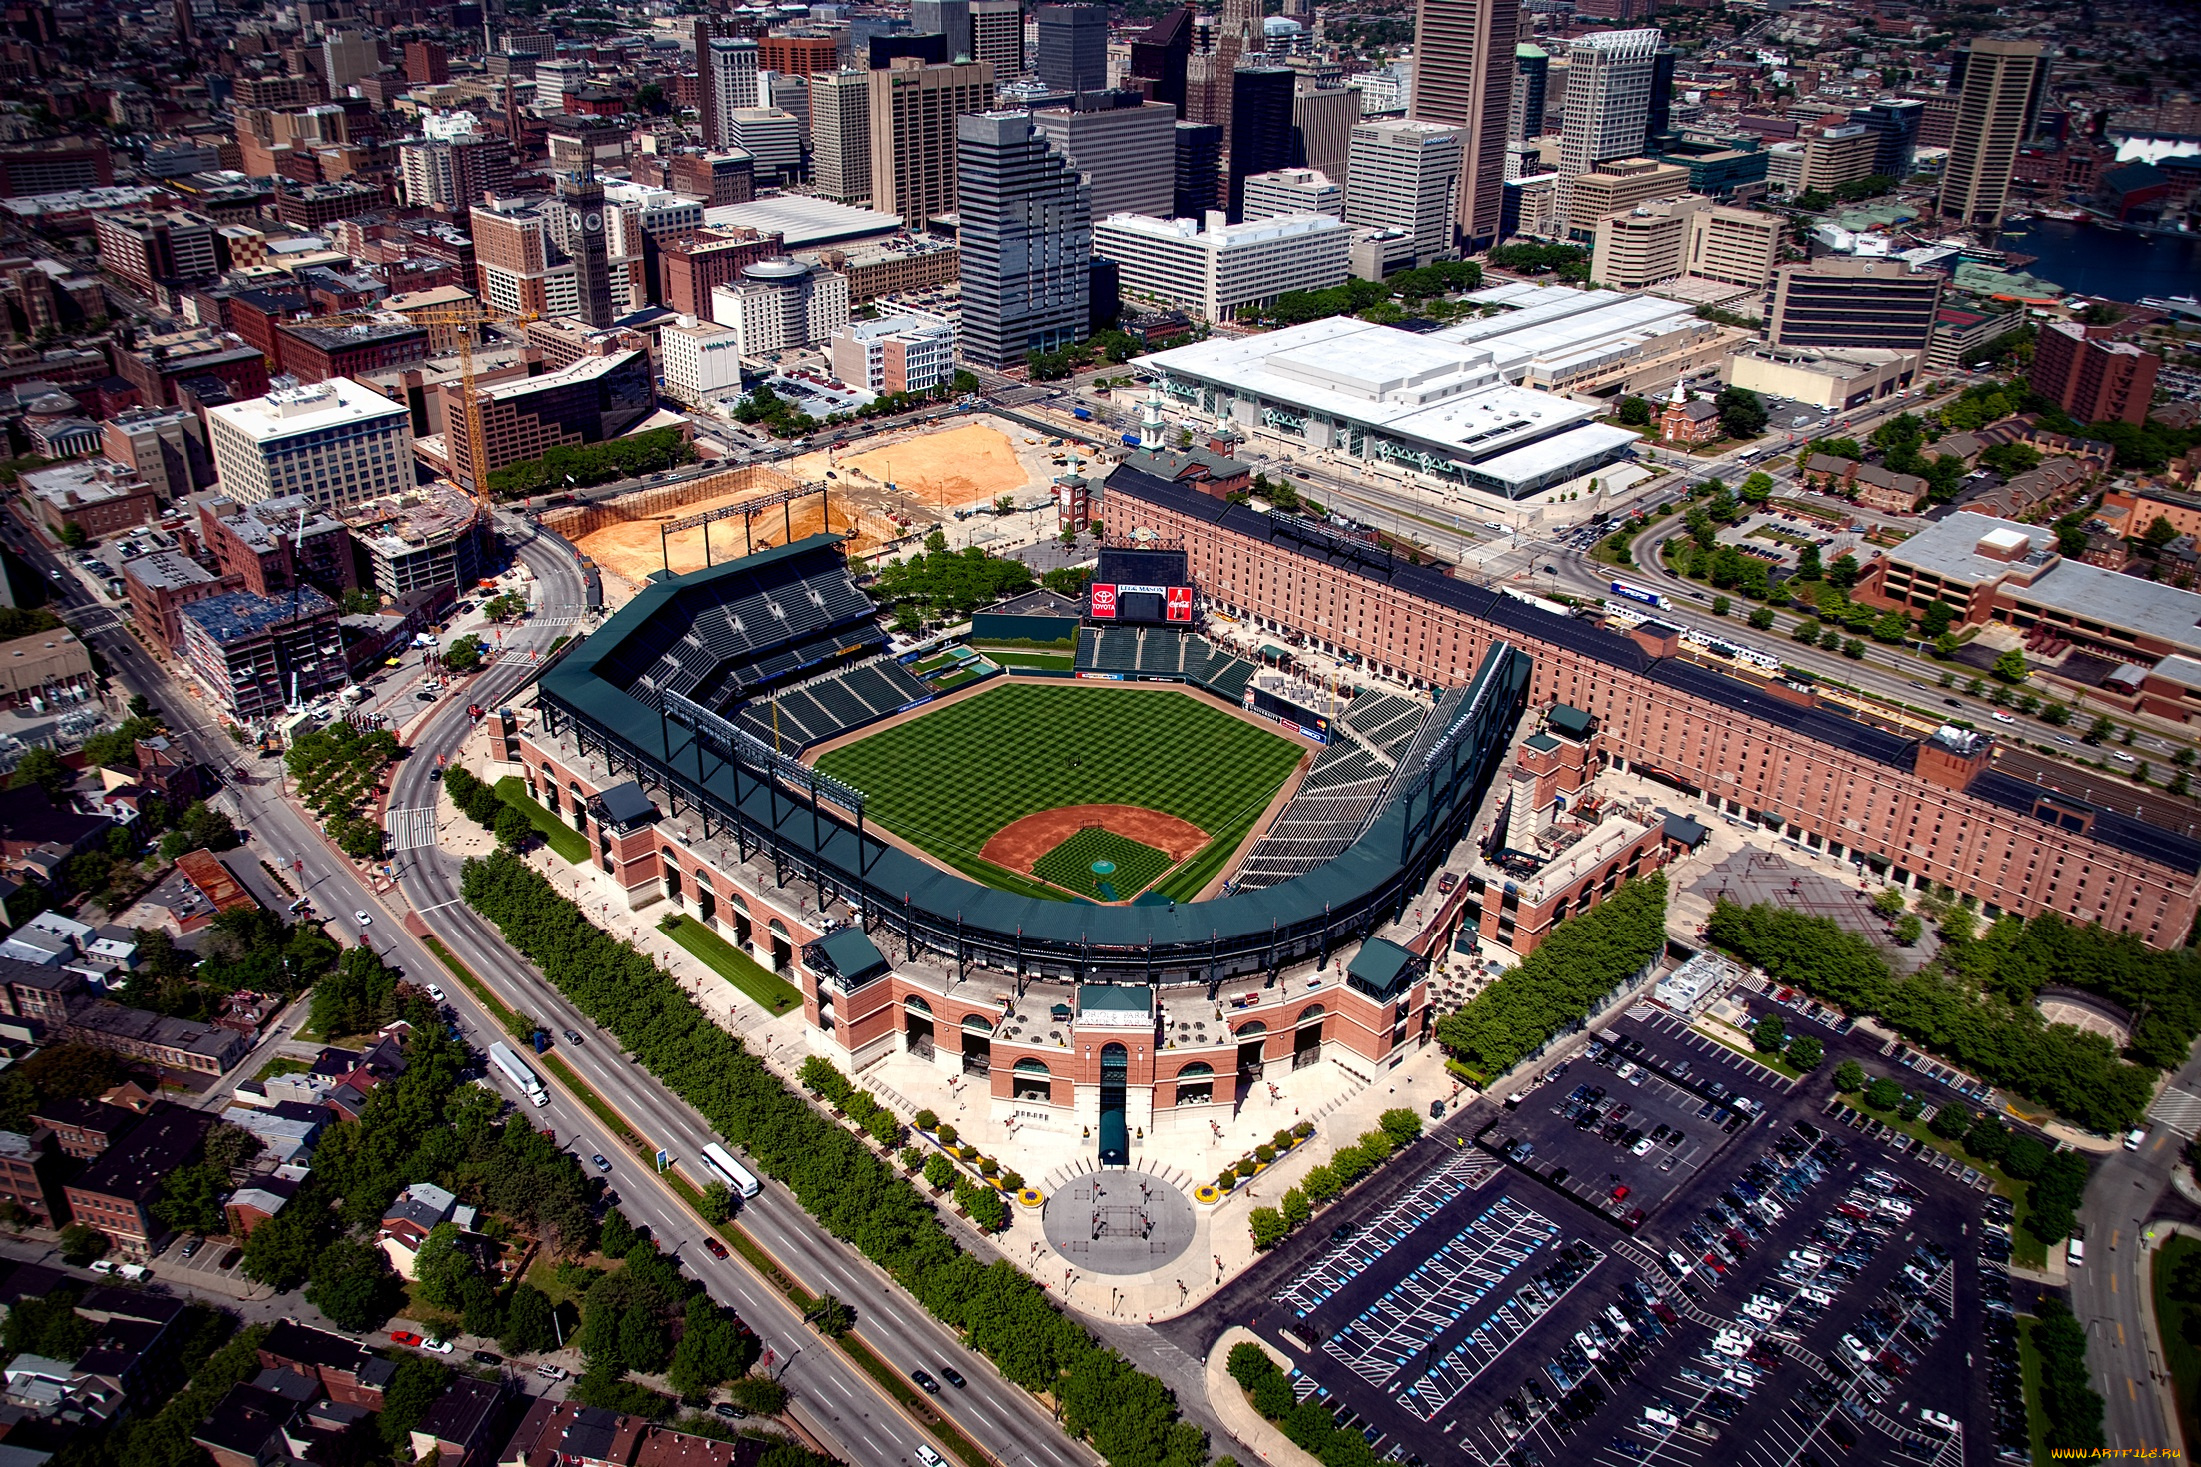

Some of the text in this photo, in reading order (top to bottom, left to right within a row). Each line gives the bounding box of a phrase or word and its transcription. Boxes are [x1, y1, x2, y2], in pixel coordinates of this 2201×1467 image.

[1625, 589, 1650, 601] PEPSI
[1092, 603, 1116, 611] TOYOTA
[1083, 1010, 1147, 1019] ORIOLE PARK
